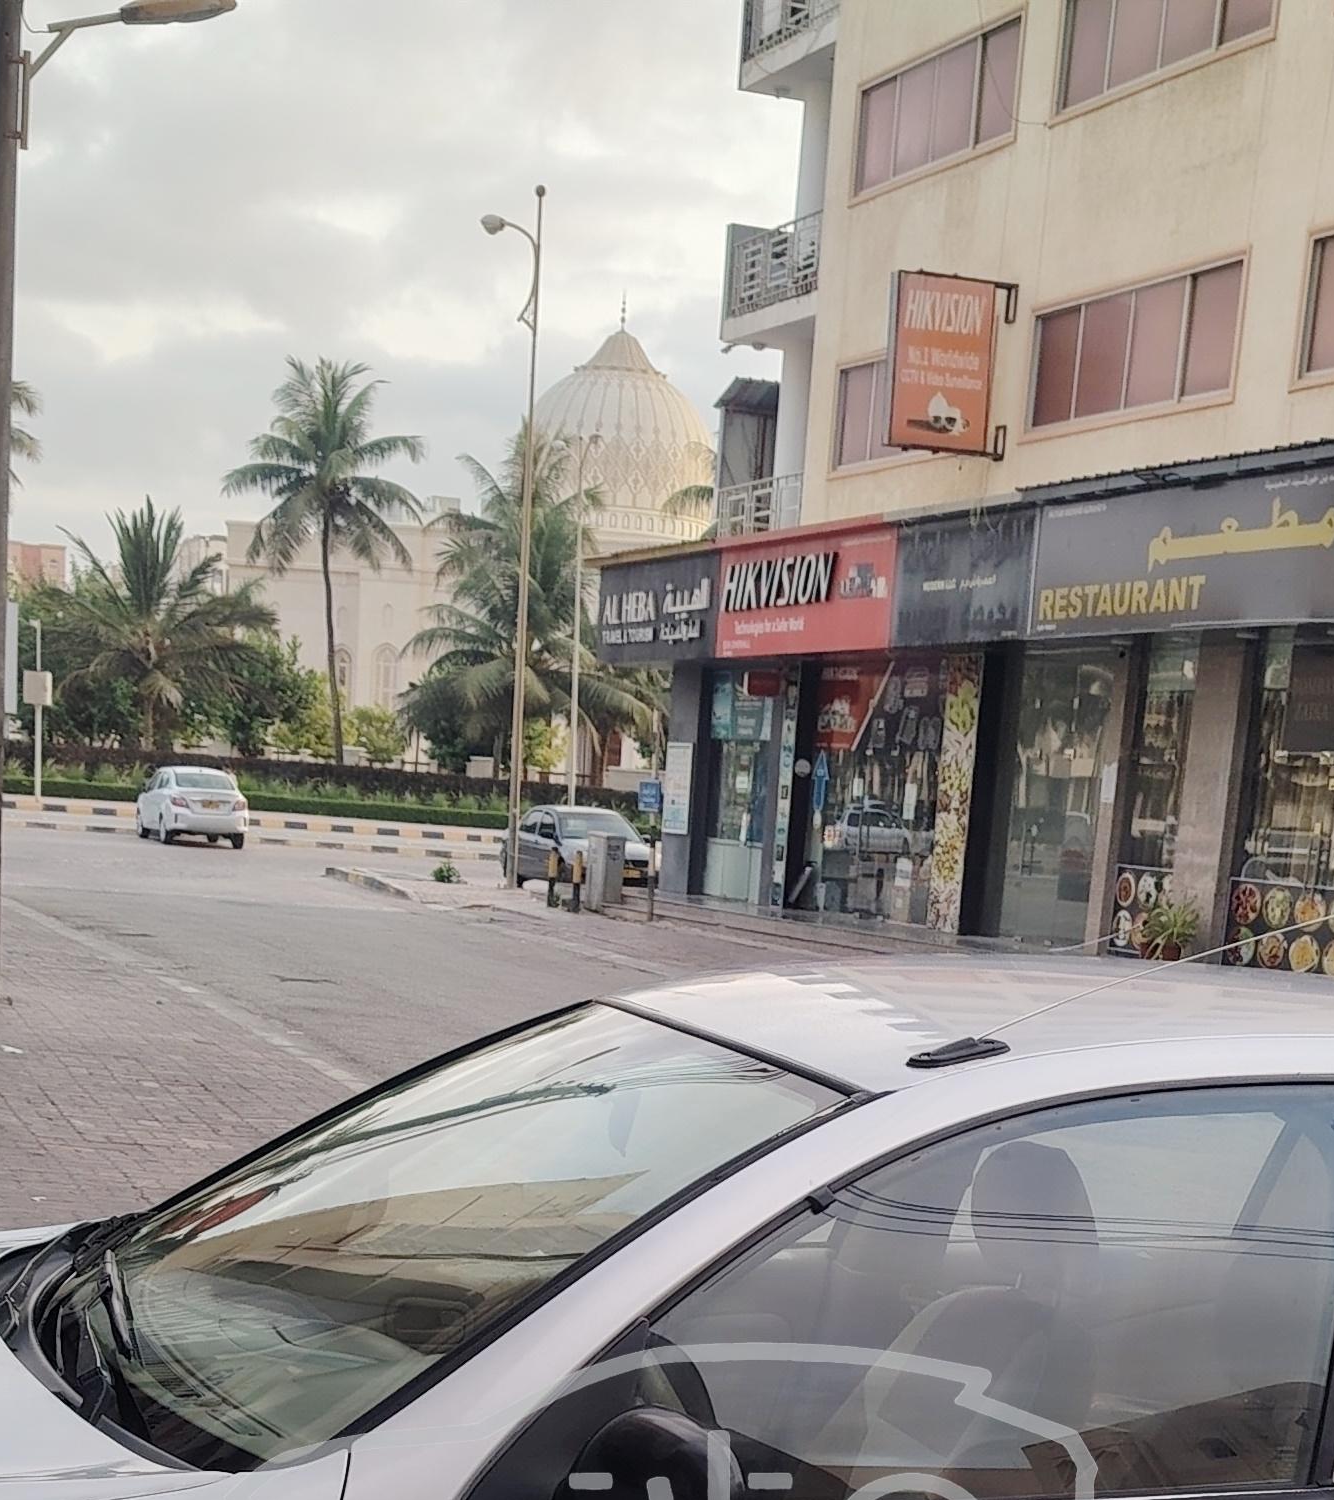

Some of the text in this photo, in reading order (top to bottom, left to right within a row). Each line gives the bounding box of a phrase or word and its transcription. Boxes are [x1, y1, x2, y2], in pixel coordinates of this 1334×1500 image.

[904, 288, 986, 337] HIKVISION
[721, 551, 836, 612] HIKVISION
[1037, 574, 1207, 621] RESTAURANT
